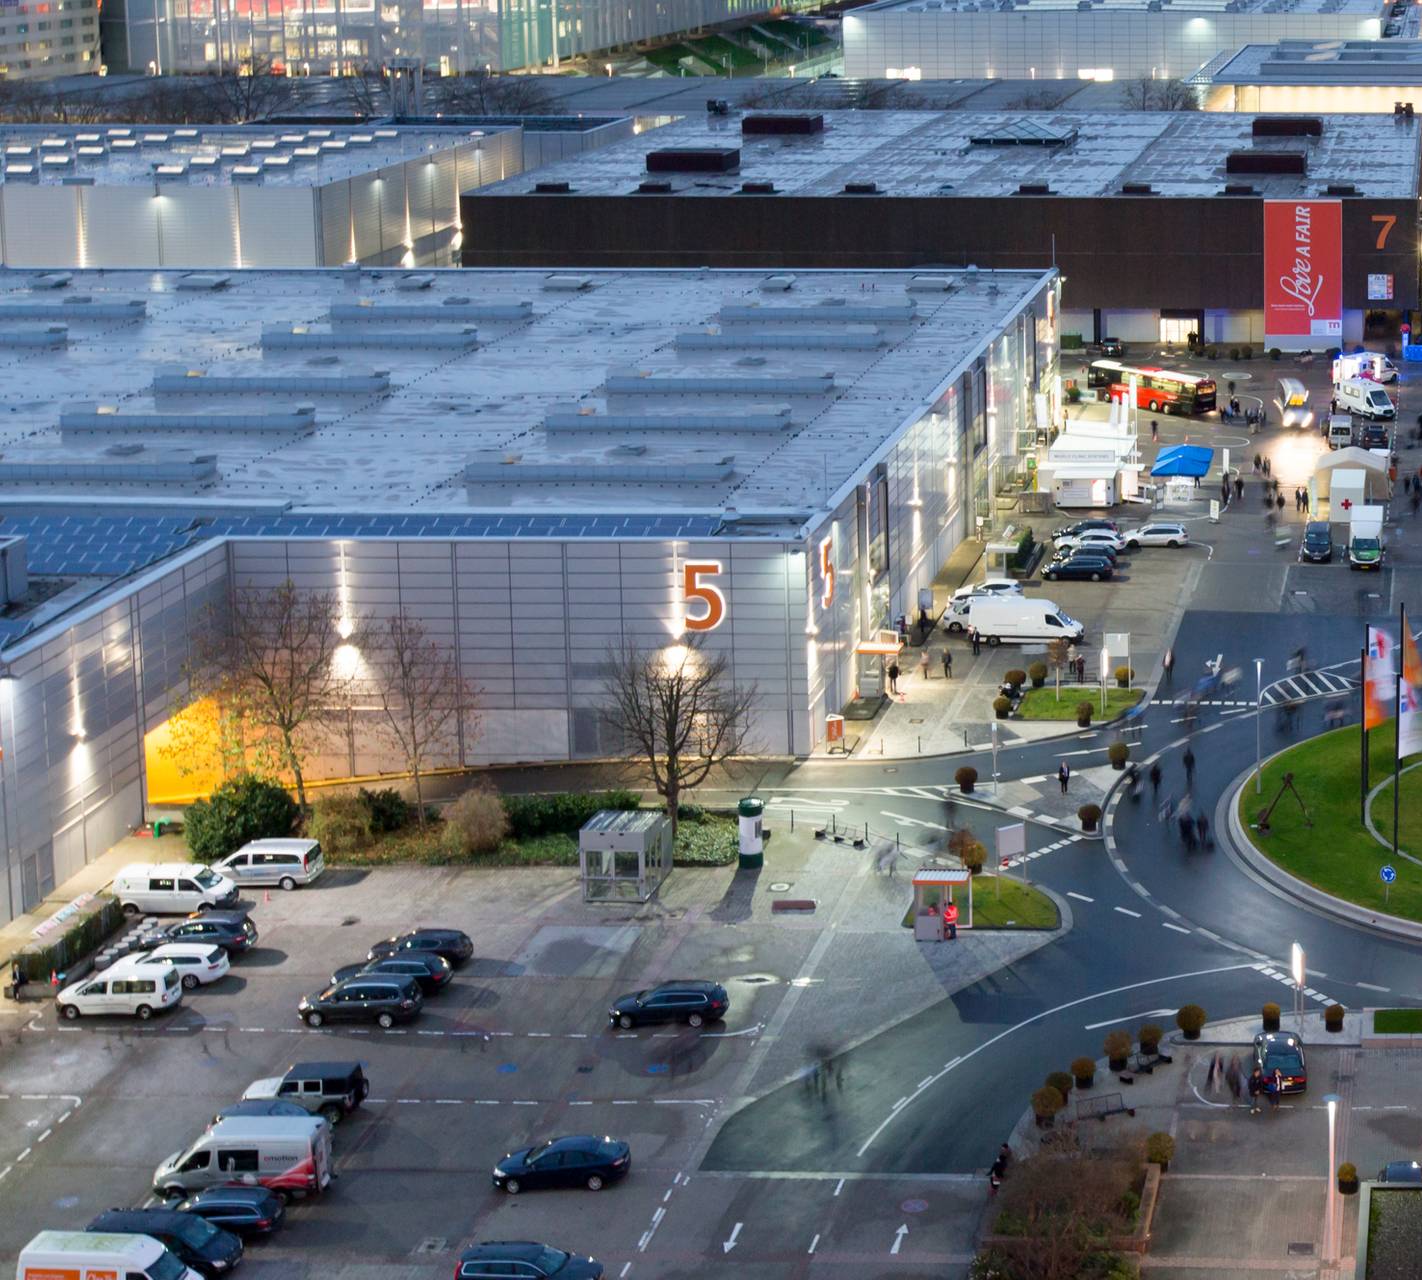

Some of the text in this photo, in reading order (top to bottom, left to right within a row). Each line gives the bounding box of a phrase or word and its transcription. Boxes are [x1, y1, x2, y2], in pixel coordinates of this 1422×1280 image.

[1296, 206, 1311, 243] FAIR
[1371, 215, 1397, 250] 7
[1296, 246, 1311, 257] A
[1280, 258, 1323, 317] Love
[682, 560, 727, 633] 5
[818, 536, 836, 610] 5
